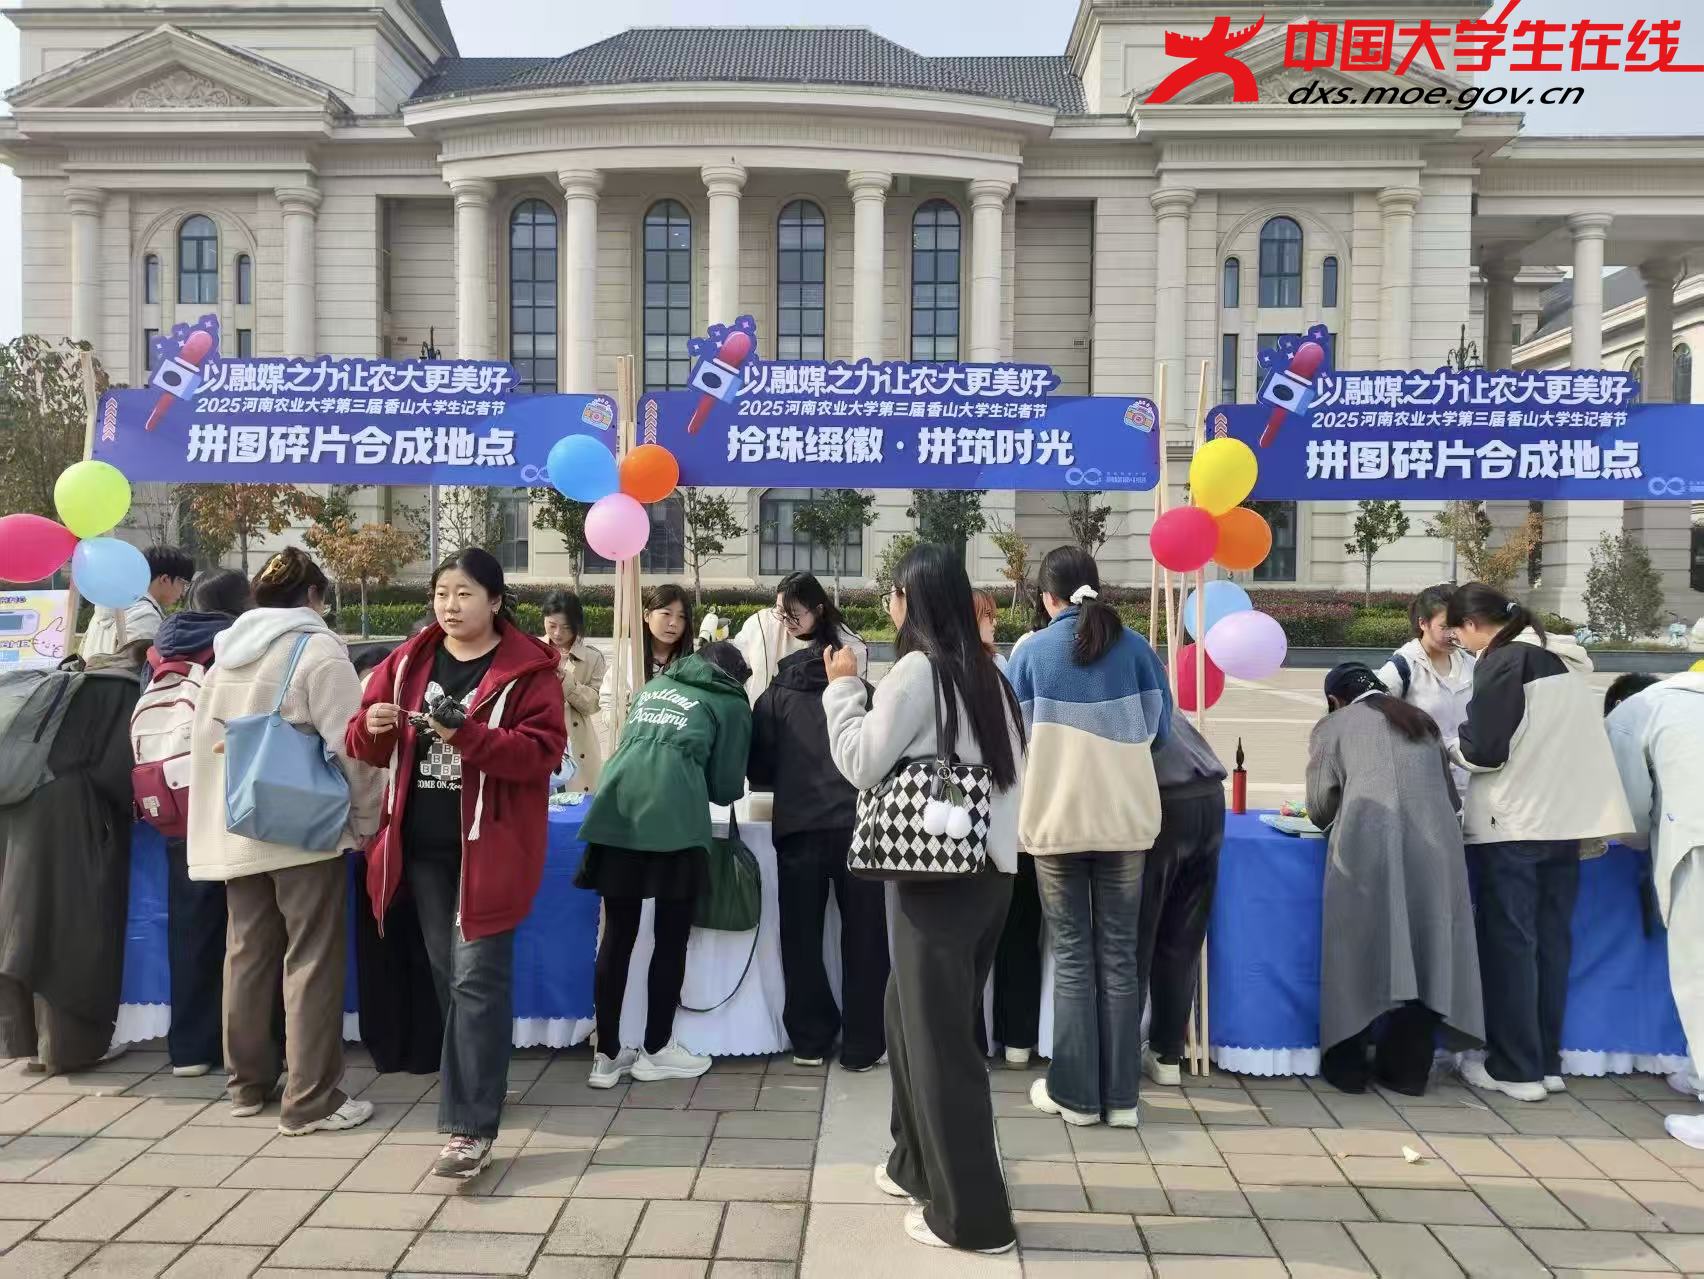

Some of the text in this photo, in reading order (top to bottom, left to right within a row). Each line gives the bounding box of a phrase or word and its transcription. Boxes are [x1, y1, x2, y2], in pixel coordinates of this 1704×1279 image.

[197, 361, 513, 396] 以融媒之力让农大更美好
[737, 364, 1054, 398] 以融媒之力让农大更美好
[1310, 373, 1634, 407] 以融媒之力让农大更美好
[195, 395, 506, 417] 2025河南农业大学第三届香山大学生记者节
[737, 399, 1048, 420] 2025河南农业大学第三届香山大学生记者节
[1311, 409, 1629, 429] 2025河南农业大学第三届香山大学生记者节
[186, 424, 517, 467] 拼图碎片合成地点
[1305, 439, 1646, 481] 拼图碎片合成地点
[629, 707, 688, 731] Academy
